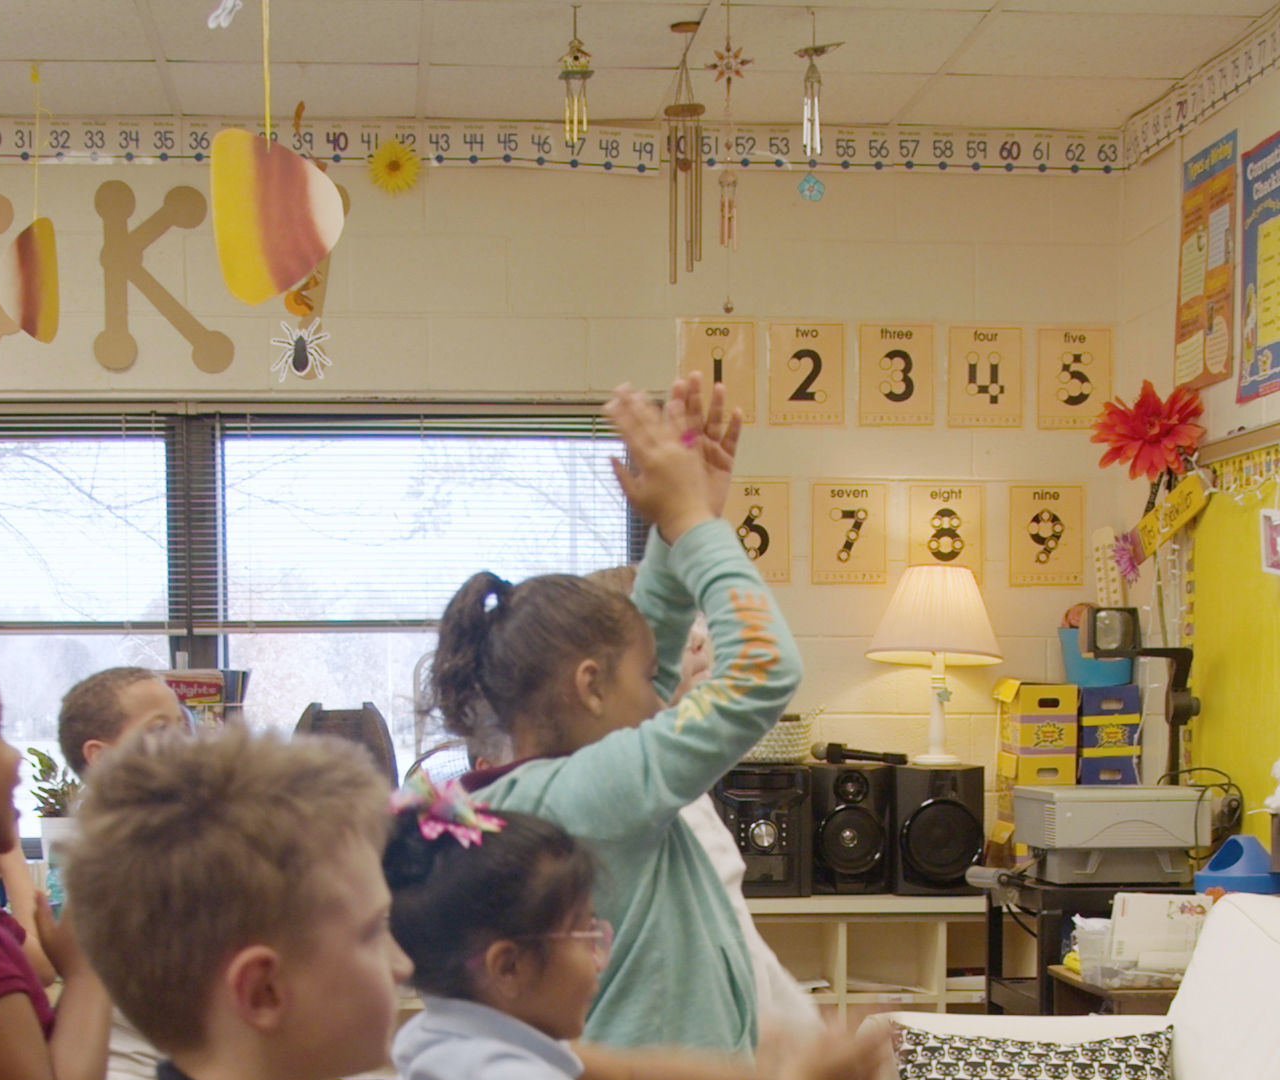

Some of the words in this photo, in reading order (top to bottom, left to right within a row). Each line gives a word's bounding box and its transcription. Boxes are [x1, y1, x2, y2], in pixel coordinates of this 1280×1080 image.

[1177, 101, 1187, 121] 70
[15, 129, 33, 149] 31
[49, 129, 71, 149] 32
[84, 129, 105, 150] 33
[119, 129, 140, 150] 34
[153, 129, 175, 150] 35
[189, 131, 210, 150] 36
[292, 131, 313, 150] 39
[326, 131, 348, 151] 40
[361, 132, 379, 152] 41
[429, 133, 451, 152] 43
[463, 132, 484, 152] 44
[497, 132, 518, 152] 45
[531, 134, 552, 154] 46
[565, 137, 586, 157] 47
[599, 137, 620, 158] 48
[632, 140, 654, 161] 49
[701, 135, 719, 156] 51
[735, 136, 756, 156] 52
[769, 136, 790, 156] 53
[836, 138, 856, 158] 55
[869, 139, 889, 159] 56
[899, 139, 920, 159] 57
[933, 139, 954, 159] 58
[966, 140, 987, 160] 59
[999, 141, 1021, 161] 60
[1032, 142, 1050, 162] 61
[1065, 143, 1086, 163] 62
[1097, 143, 1118, 163] 63
[705, 328, 730, 338] one
[795, 327, 819, 339] two
[880, 328, 913, 340] three
[973, 329, 998, 342] four
[1063, 331, 1087, 344] five
[787, 348, 827, 402] 2
[879, 348, 915, 402] 3
[966, 350, 1005, 405] 4
[1057, 352, 1093, 406] 5
[743, 484, 761, 497] six
[830, 486, 869, 498] seven
[930, 487, 963, 501] eight
[1032, 488, 1060, 501] nine
[736, 505, 770, 561] 6
[830, 507, 868, 562] 7
[927, 508, 964, 562] 8
[1028, 509, 1065, 563] 9
